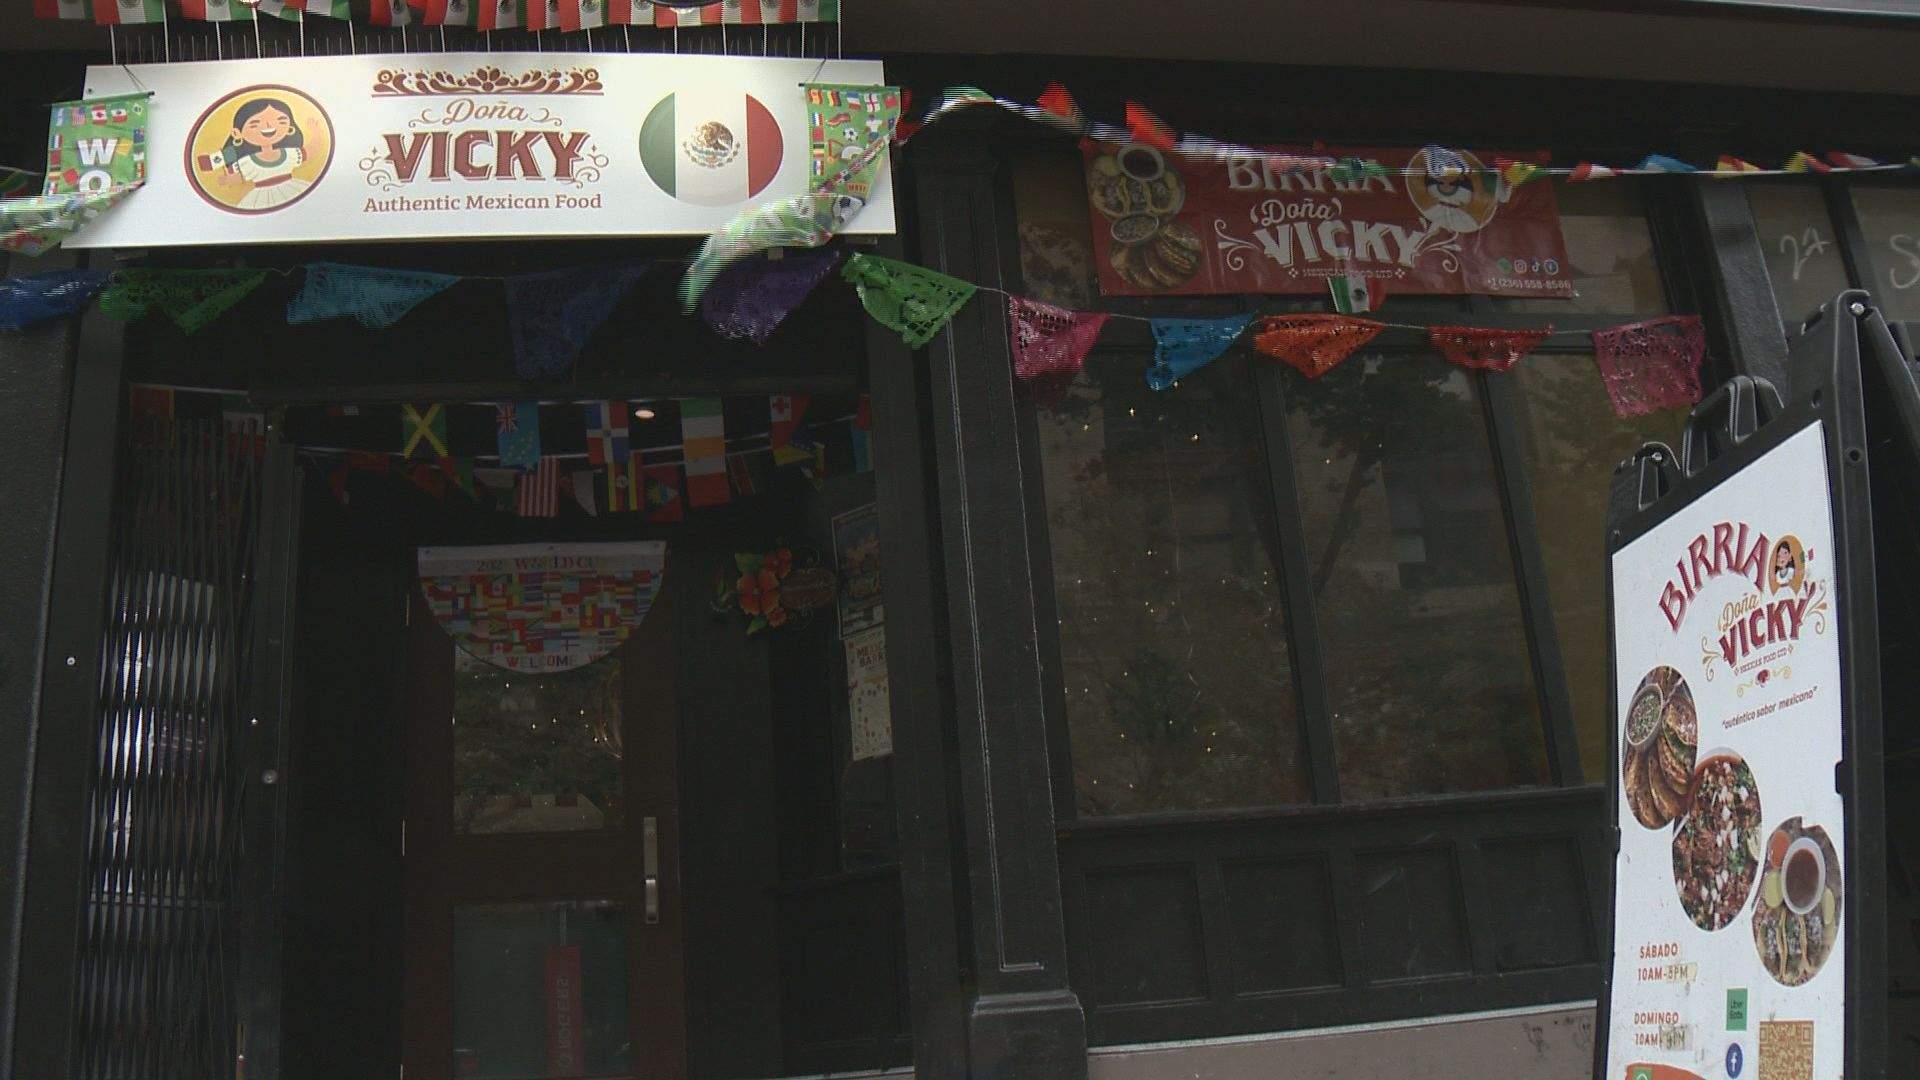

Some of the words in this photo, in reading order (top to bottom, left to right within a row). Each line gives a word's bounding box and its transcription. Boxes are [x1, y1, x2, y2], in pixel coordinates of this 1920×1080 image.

[442, 98, 529, 124] Doña
[383, 130, 590, 182] VICKY
[363, 197, 460, 213] Authentic
[466, 195, 549, 210] Mexican
[555, 193, 602, 209] Food
[1260, 198, 1332, 226] Doña
[1253, 217, 1434, 268] VICKY
[1658, 521, 1771, 632] BIRRIA
[1718, 581, 1815, 667] VICKY
[1721, 592, 1760, 631] Doña
[506, 655, 577, 669] WELOME
[1756, 703, 1777, 718] sabor
[1639, 942, 1678, 959] SÁBADO
[1634, 1011, 1679, 1025] DOMINGO
